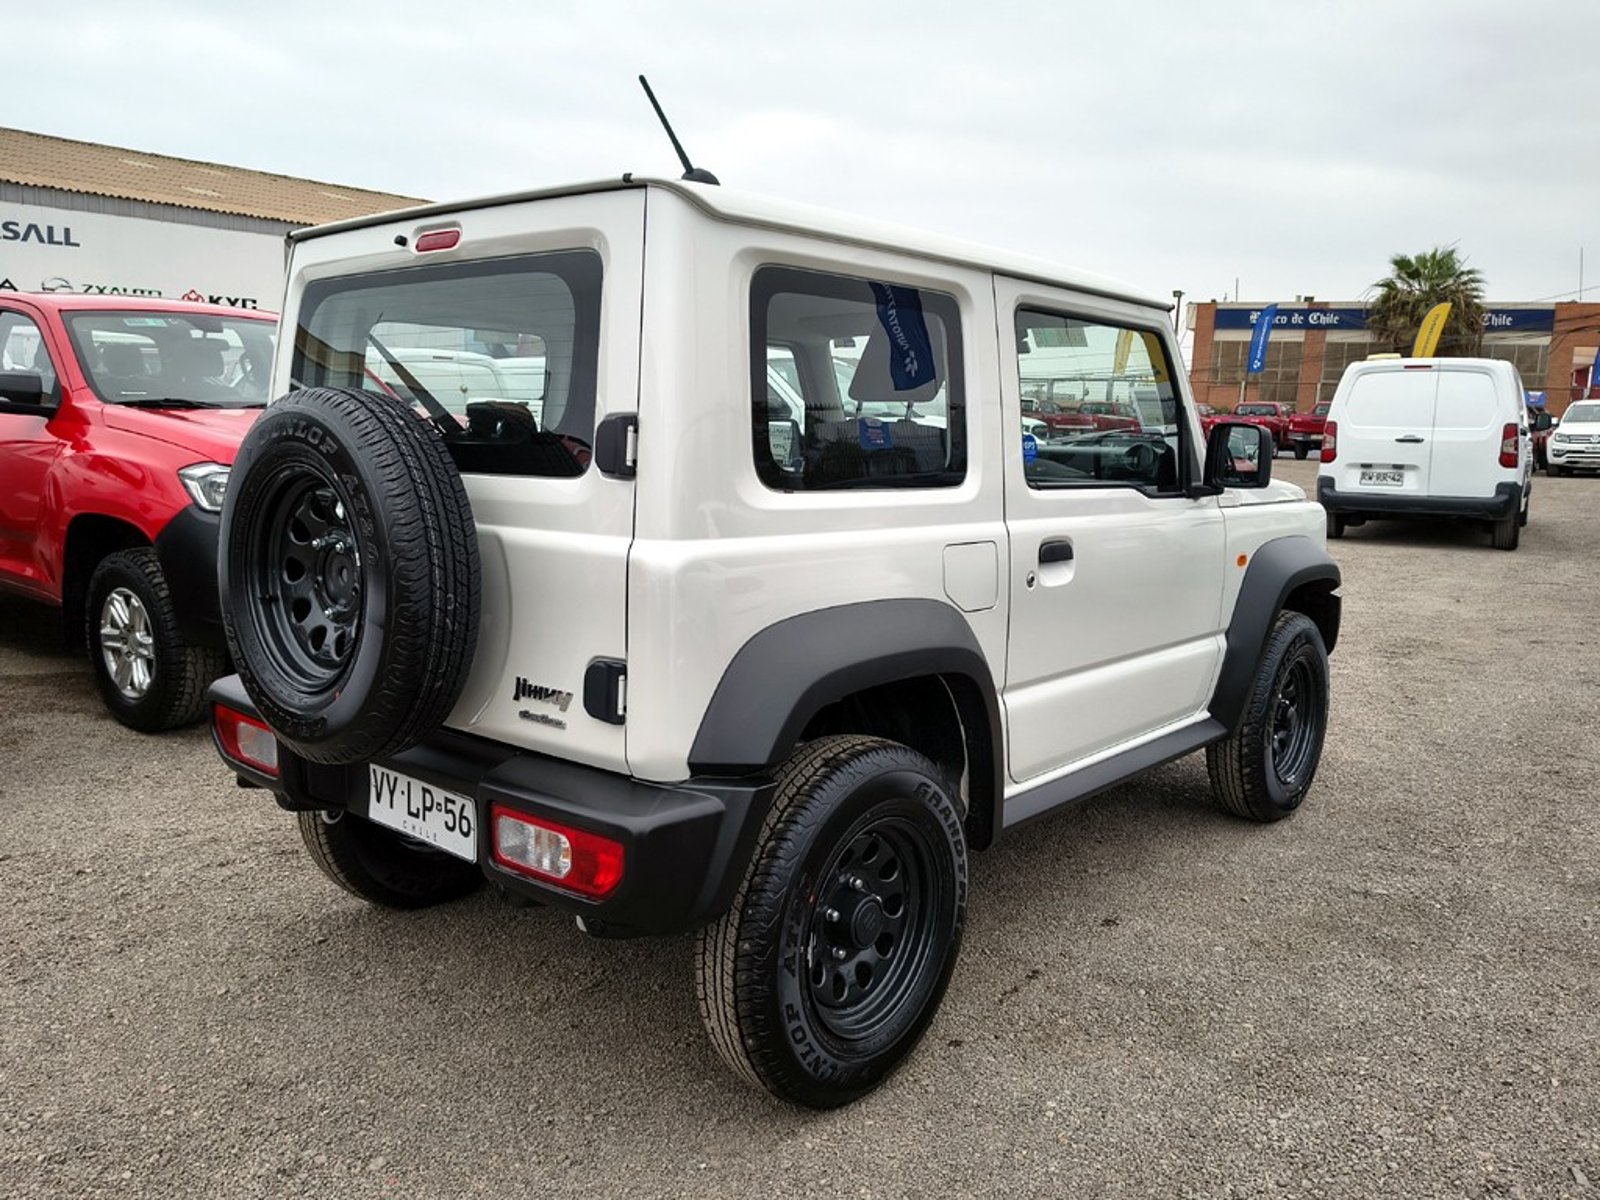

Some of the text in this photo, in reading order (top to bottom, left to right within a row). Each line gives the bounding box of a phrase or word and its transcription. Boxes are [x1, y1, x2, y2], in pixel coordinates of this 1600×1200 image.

[0, 221, 81, 248] SALL
[1249, 311, 1340, 326] Bco de Chile
[1481, 313, 1513, 327] Chile
